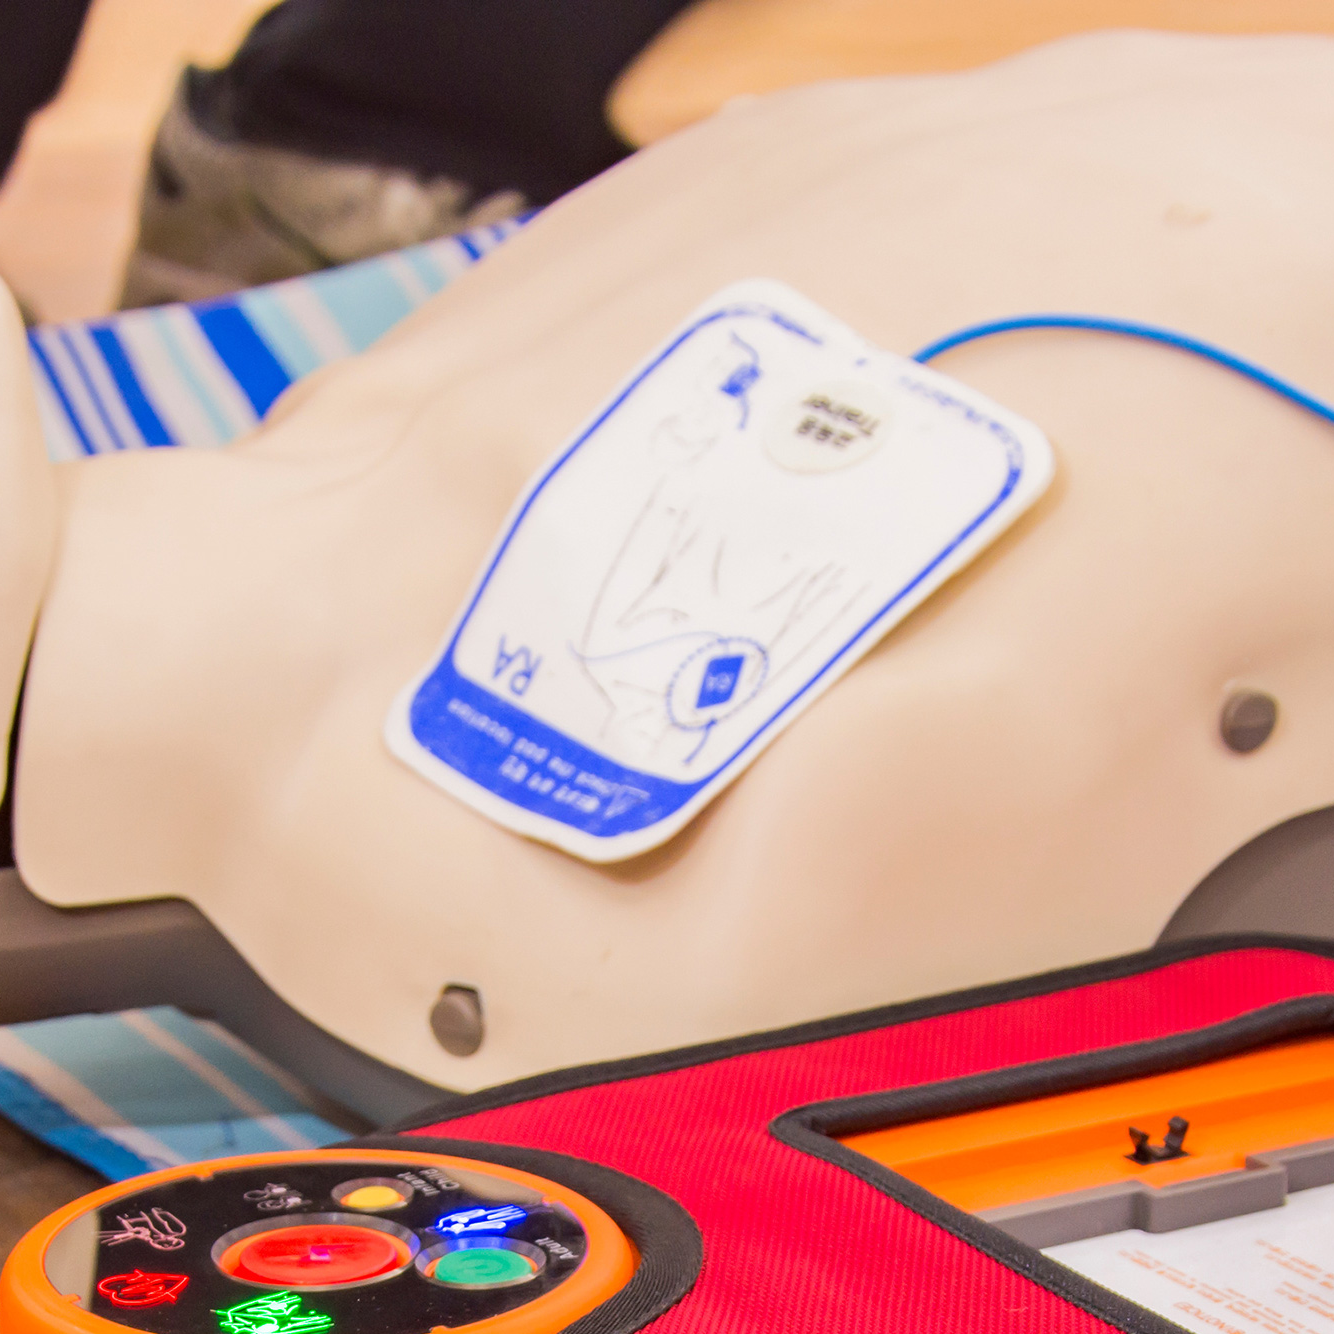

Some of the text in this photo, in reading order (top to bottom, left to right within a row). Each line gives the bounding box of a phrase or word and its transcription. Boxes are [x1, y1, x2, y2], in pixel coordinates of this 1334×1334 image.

[492, 632, 544, 697] RA
[397, 1171, 441, 1197] Infant
[419, 1168, 460, 1191] Child
[534, 1236, 579, 1261] Adult
